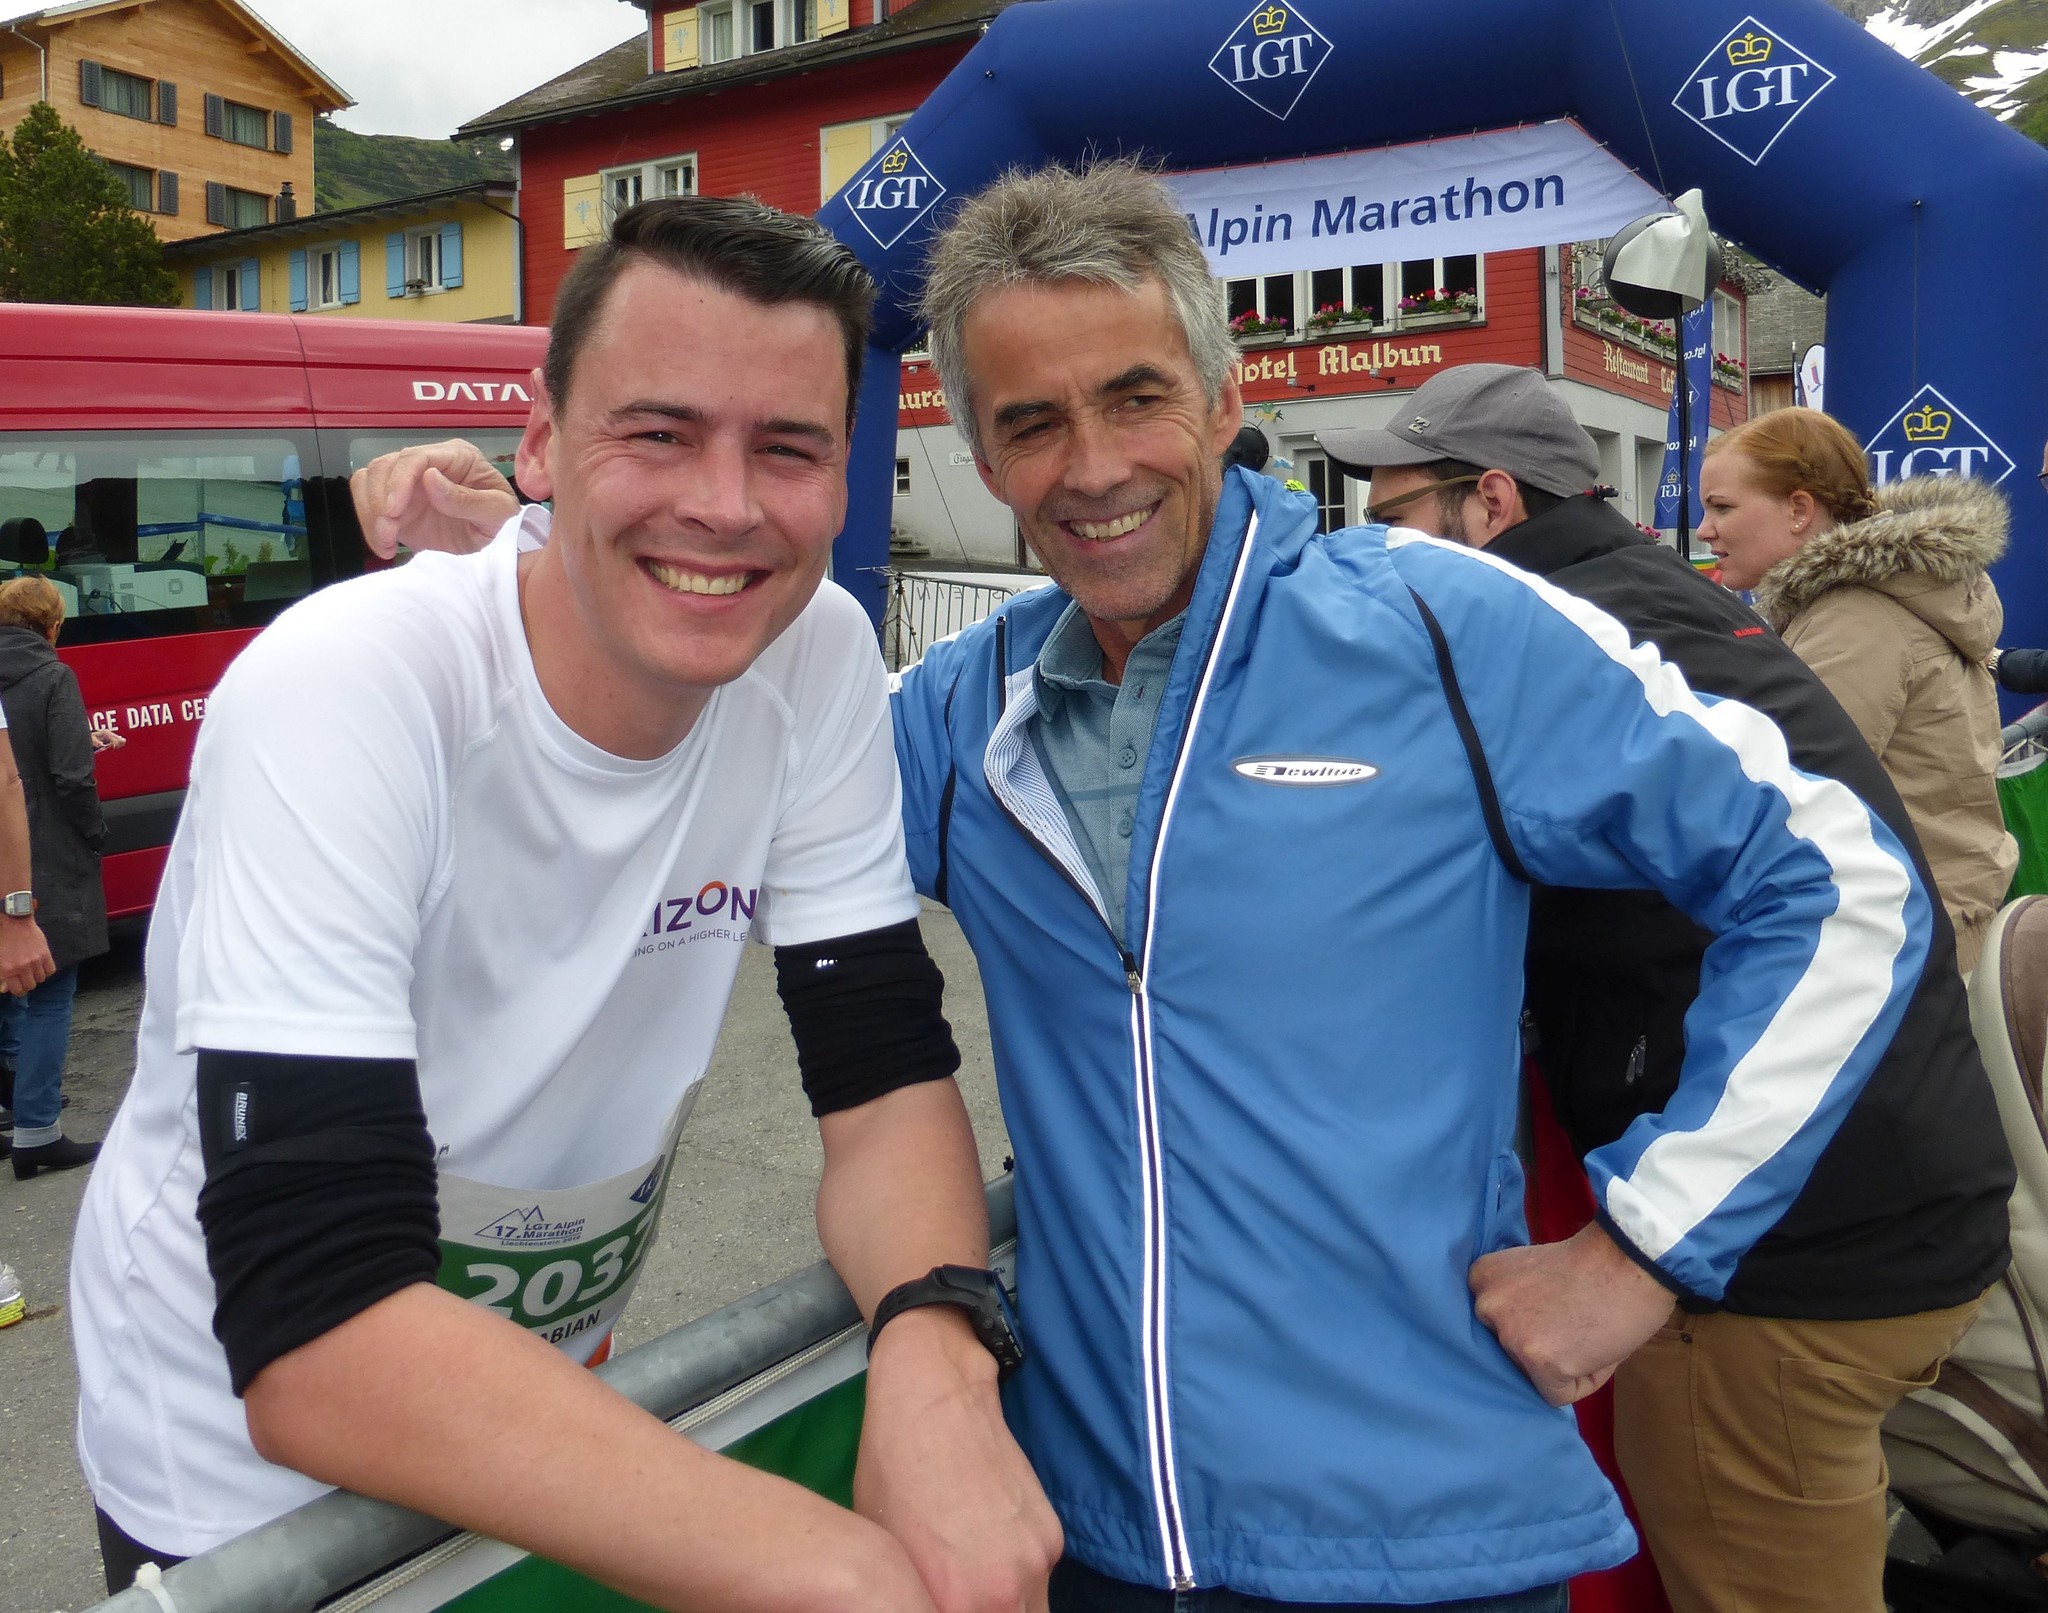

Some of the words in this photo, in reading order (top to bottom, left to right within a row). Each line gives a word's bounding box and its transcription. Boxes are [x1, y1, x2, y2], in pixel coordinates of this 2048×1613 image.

[1230, 33, 1313, 83] LGT
[1697, 63, 1808, 121] LGT
[857, 176, 927, 209] LGT
[1311, 174, 1564, 238] Marathon
[1317, 342, 1442, 376] Malbun
[412, 381, 535, 401] DATA
[1661, 366, 1675, 394] Caf
[126, 703, 174, 729] DATA
[182, 698, 207, 721] CE
[643, 880, 758, 937] IZON
[632, 944, 654, 958] ING
[658, 940, 675, 951] ON
[678, 937, 686, 946] A
[689, 929, 731, 943] HIGHER
[733, 931, 748, 942] LE
[495, 1225, 521, 1238] 17.
[523, 1226, 583, 1239] Marathon
[525, 1223, 551, 1231] LGT
[553, 1218, 586, 1231] Alpin
[540, 1309, 601, 1344] BIAN
